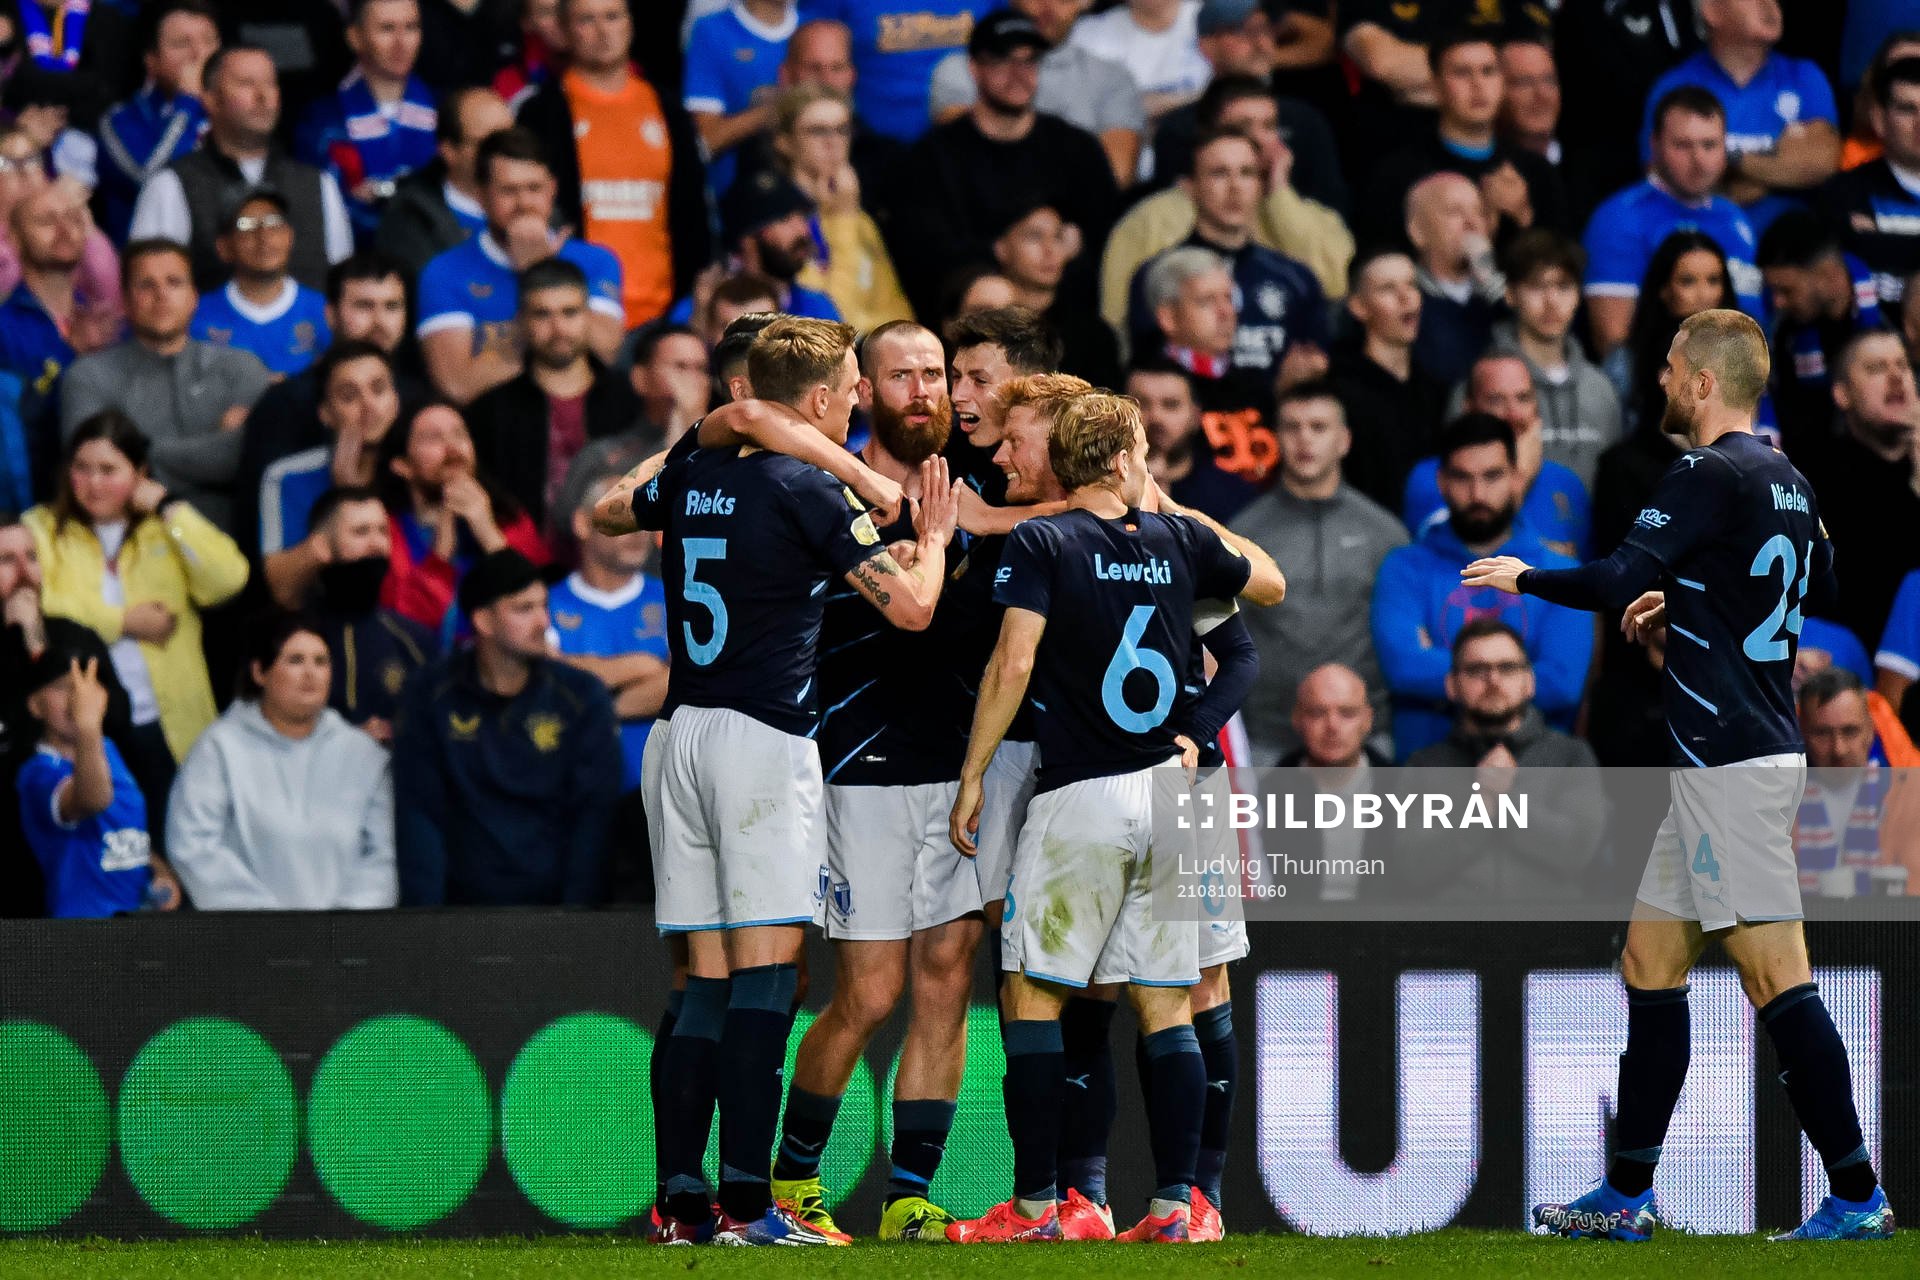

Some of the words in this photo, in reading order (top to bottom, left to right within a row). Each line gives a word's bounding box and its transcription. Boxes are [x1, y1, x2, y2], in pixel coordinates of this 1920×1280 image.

[685, 489, 736, 516] Rieks
[682, 538, 728, 666] 5
[1094, 553, 1171, 584] Lewcki
[1101, 605, 1177, 734] 6
